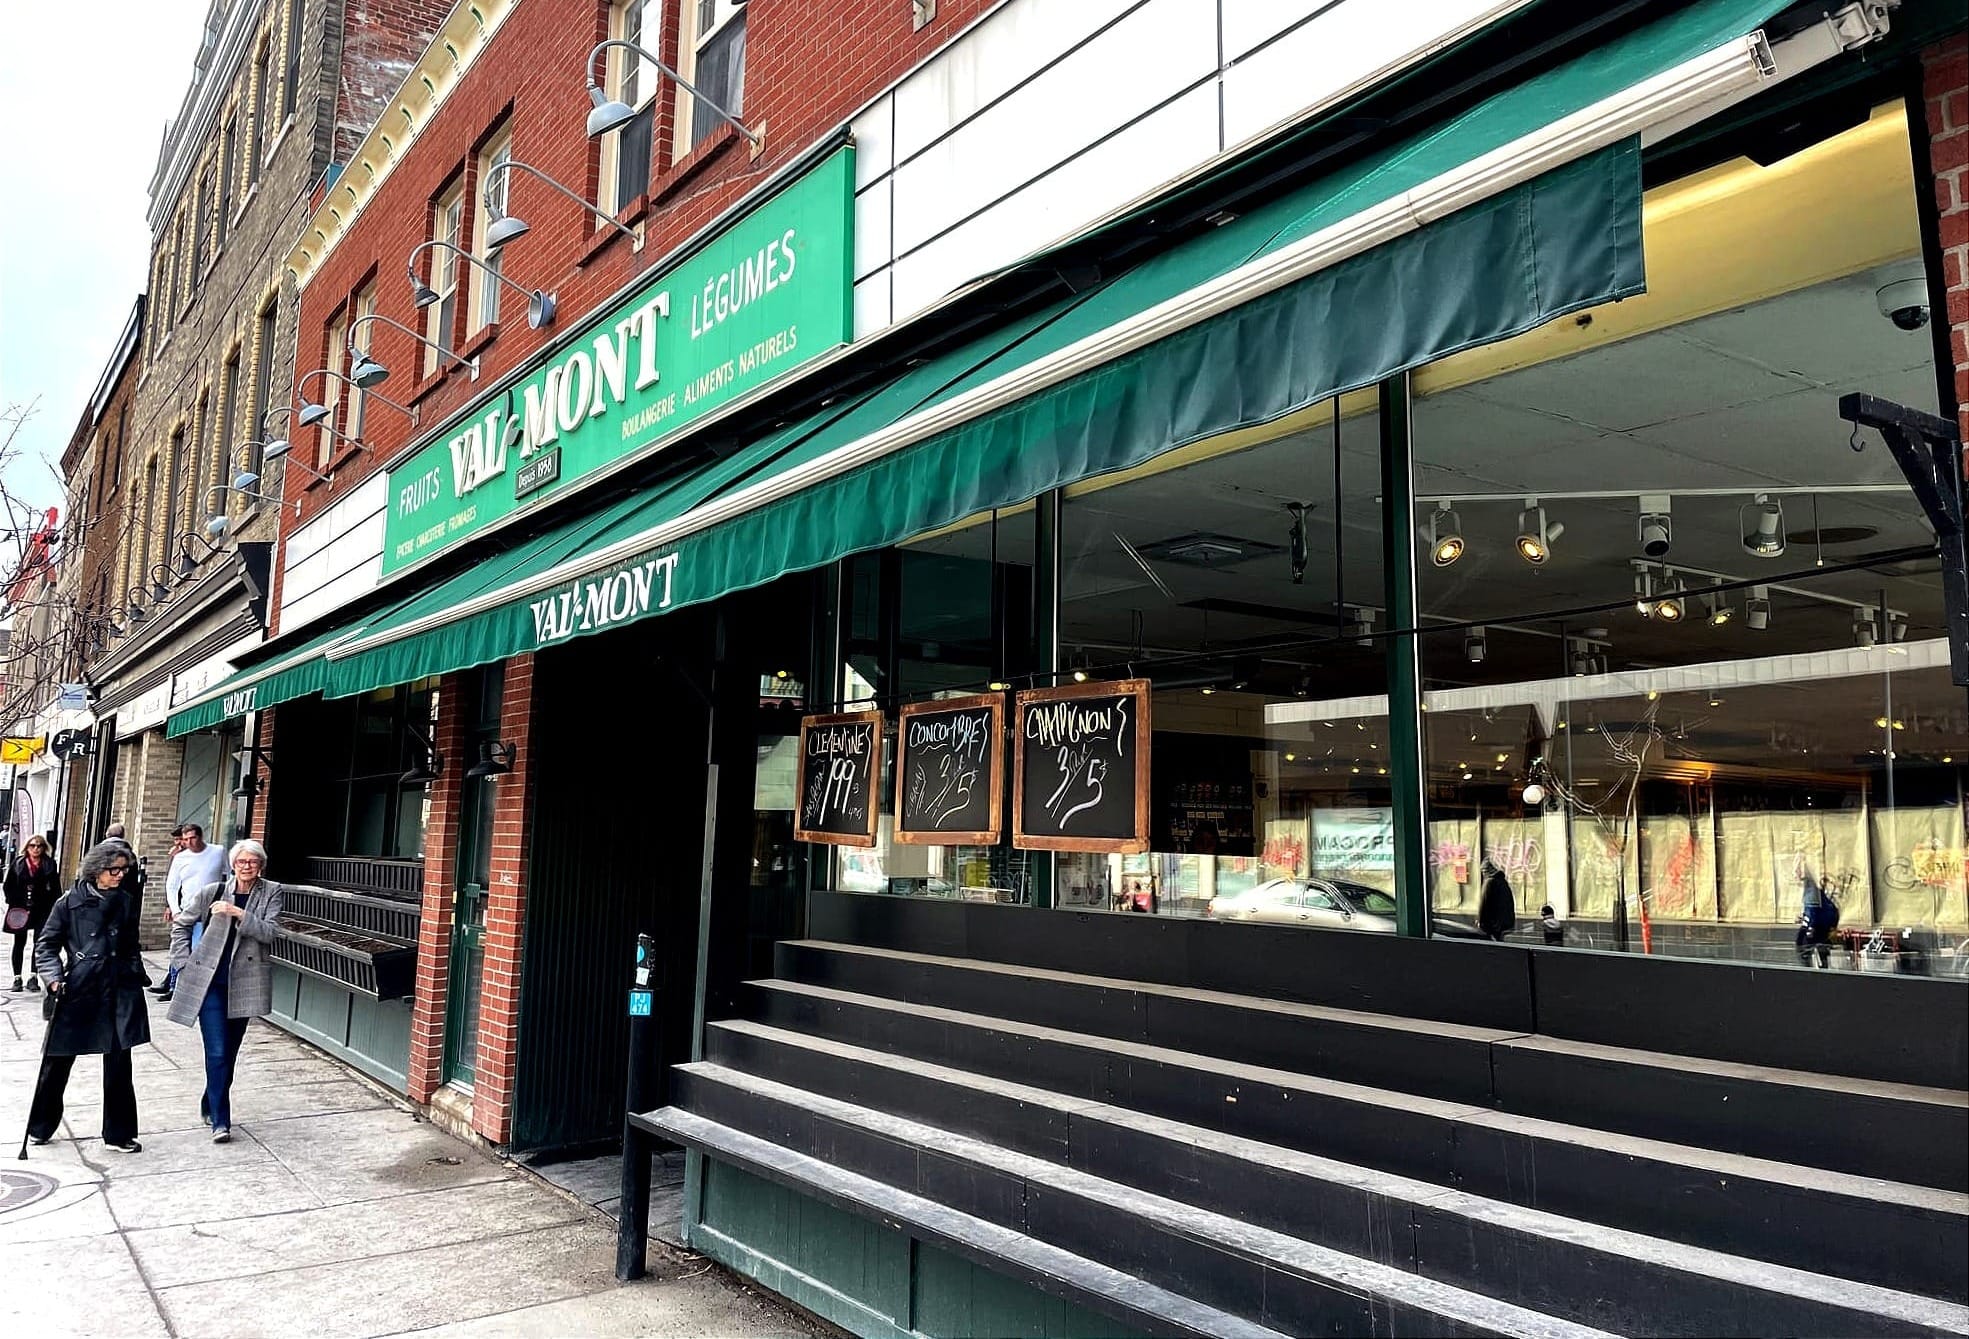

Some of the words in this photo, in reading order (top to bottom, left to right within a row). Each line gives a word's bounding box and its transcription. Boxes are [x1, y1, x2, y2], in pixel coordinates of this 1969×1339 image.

[691, 228, 796, 340] LÉGUMES
[621, 393, 676, 441] BOULANGERIE
[683, 360, 735, 407] ALIMENTS
[739, 325, 797, 376] NATURELS
[399, 466, 440, 520] FRUITS
[56, 734, 70, 745] F
[71, 742, 86, 756] R
